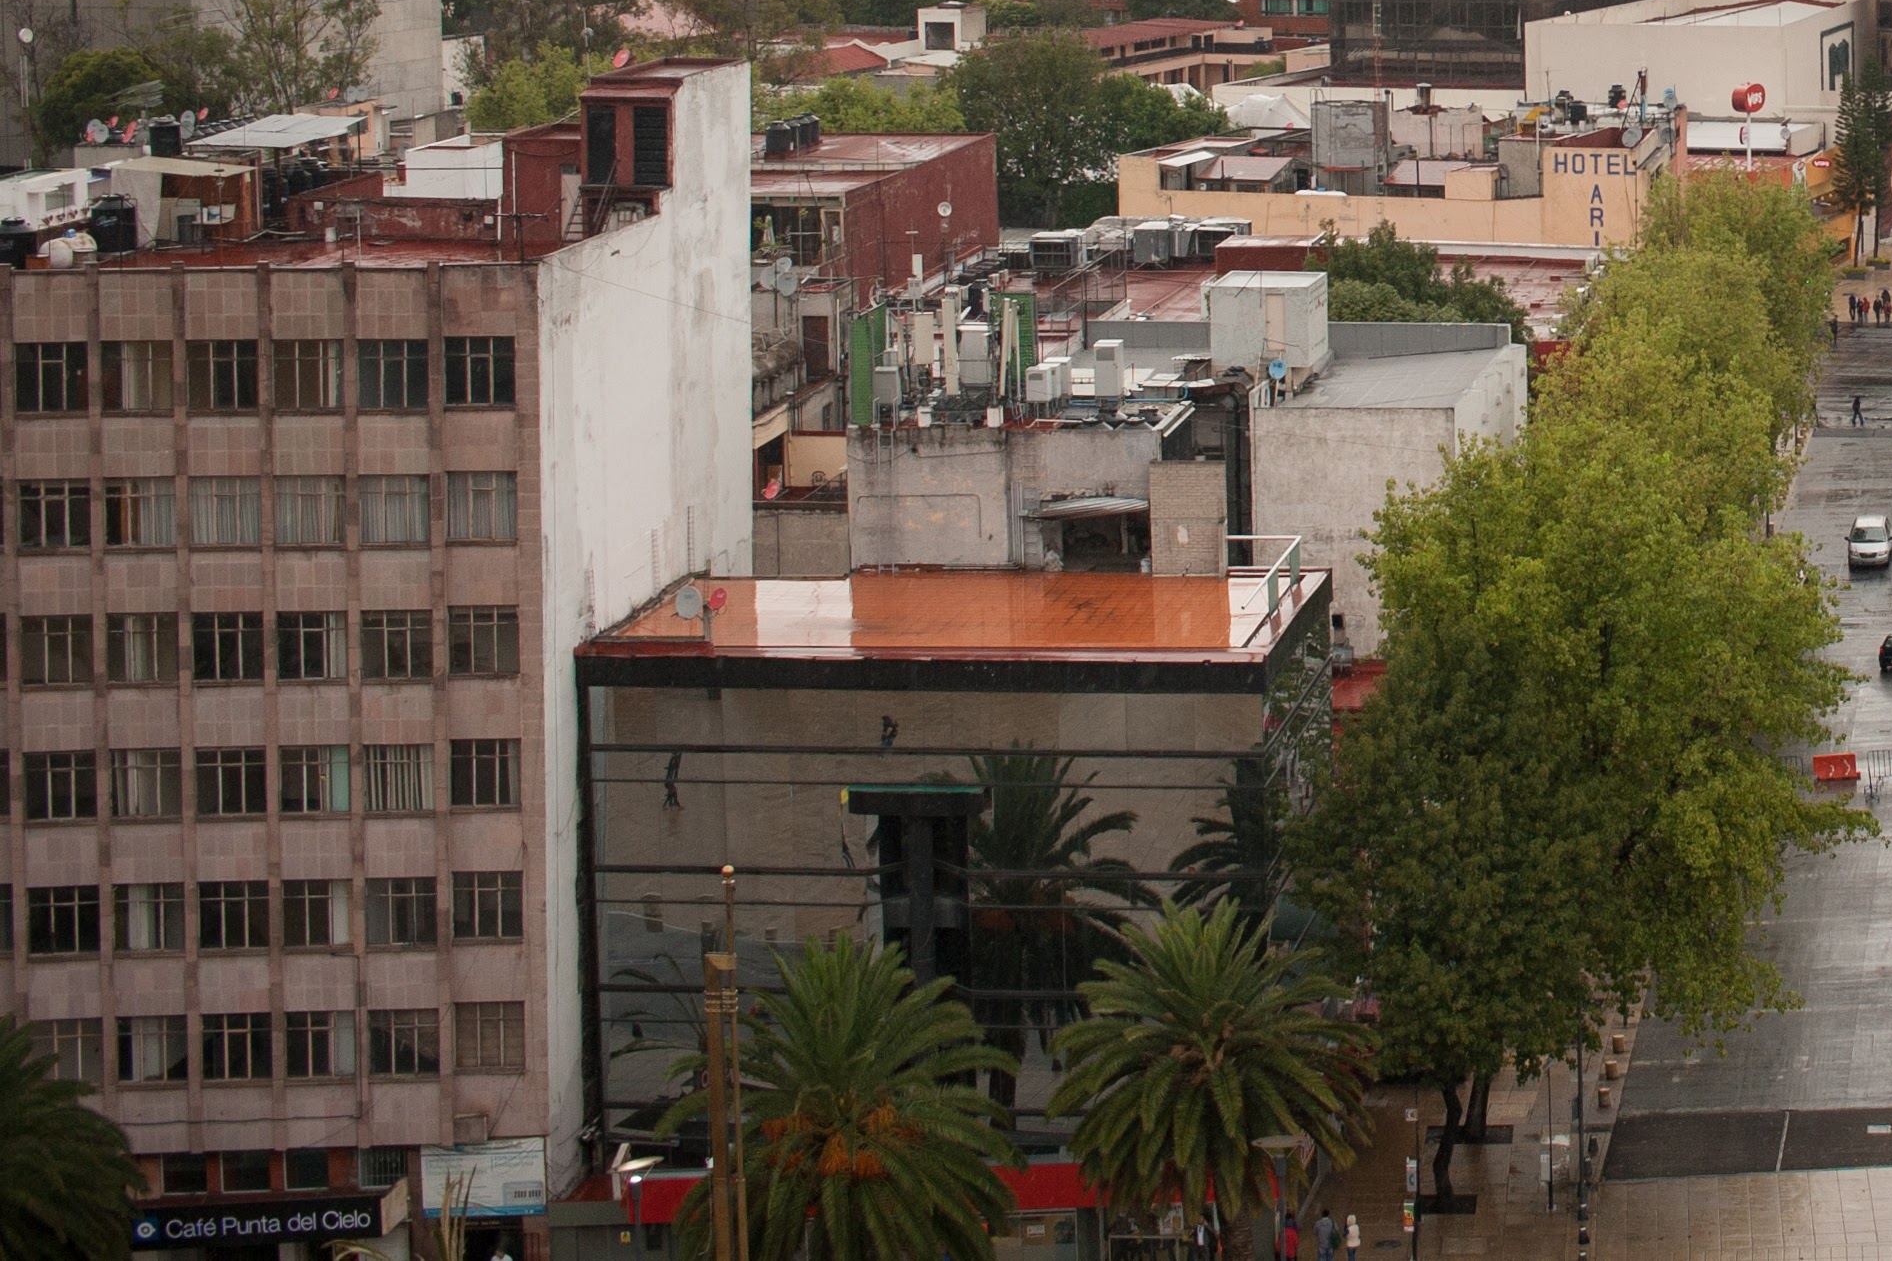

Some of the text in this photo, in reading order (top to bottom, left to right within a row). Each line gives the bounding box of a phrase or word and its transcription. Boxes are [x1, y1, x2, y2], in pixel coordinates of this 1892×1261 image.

[1554, 153, 1637, 175] HOTEL
[165, 1209, 371, 1239] Café Punta del Cielo
